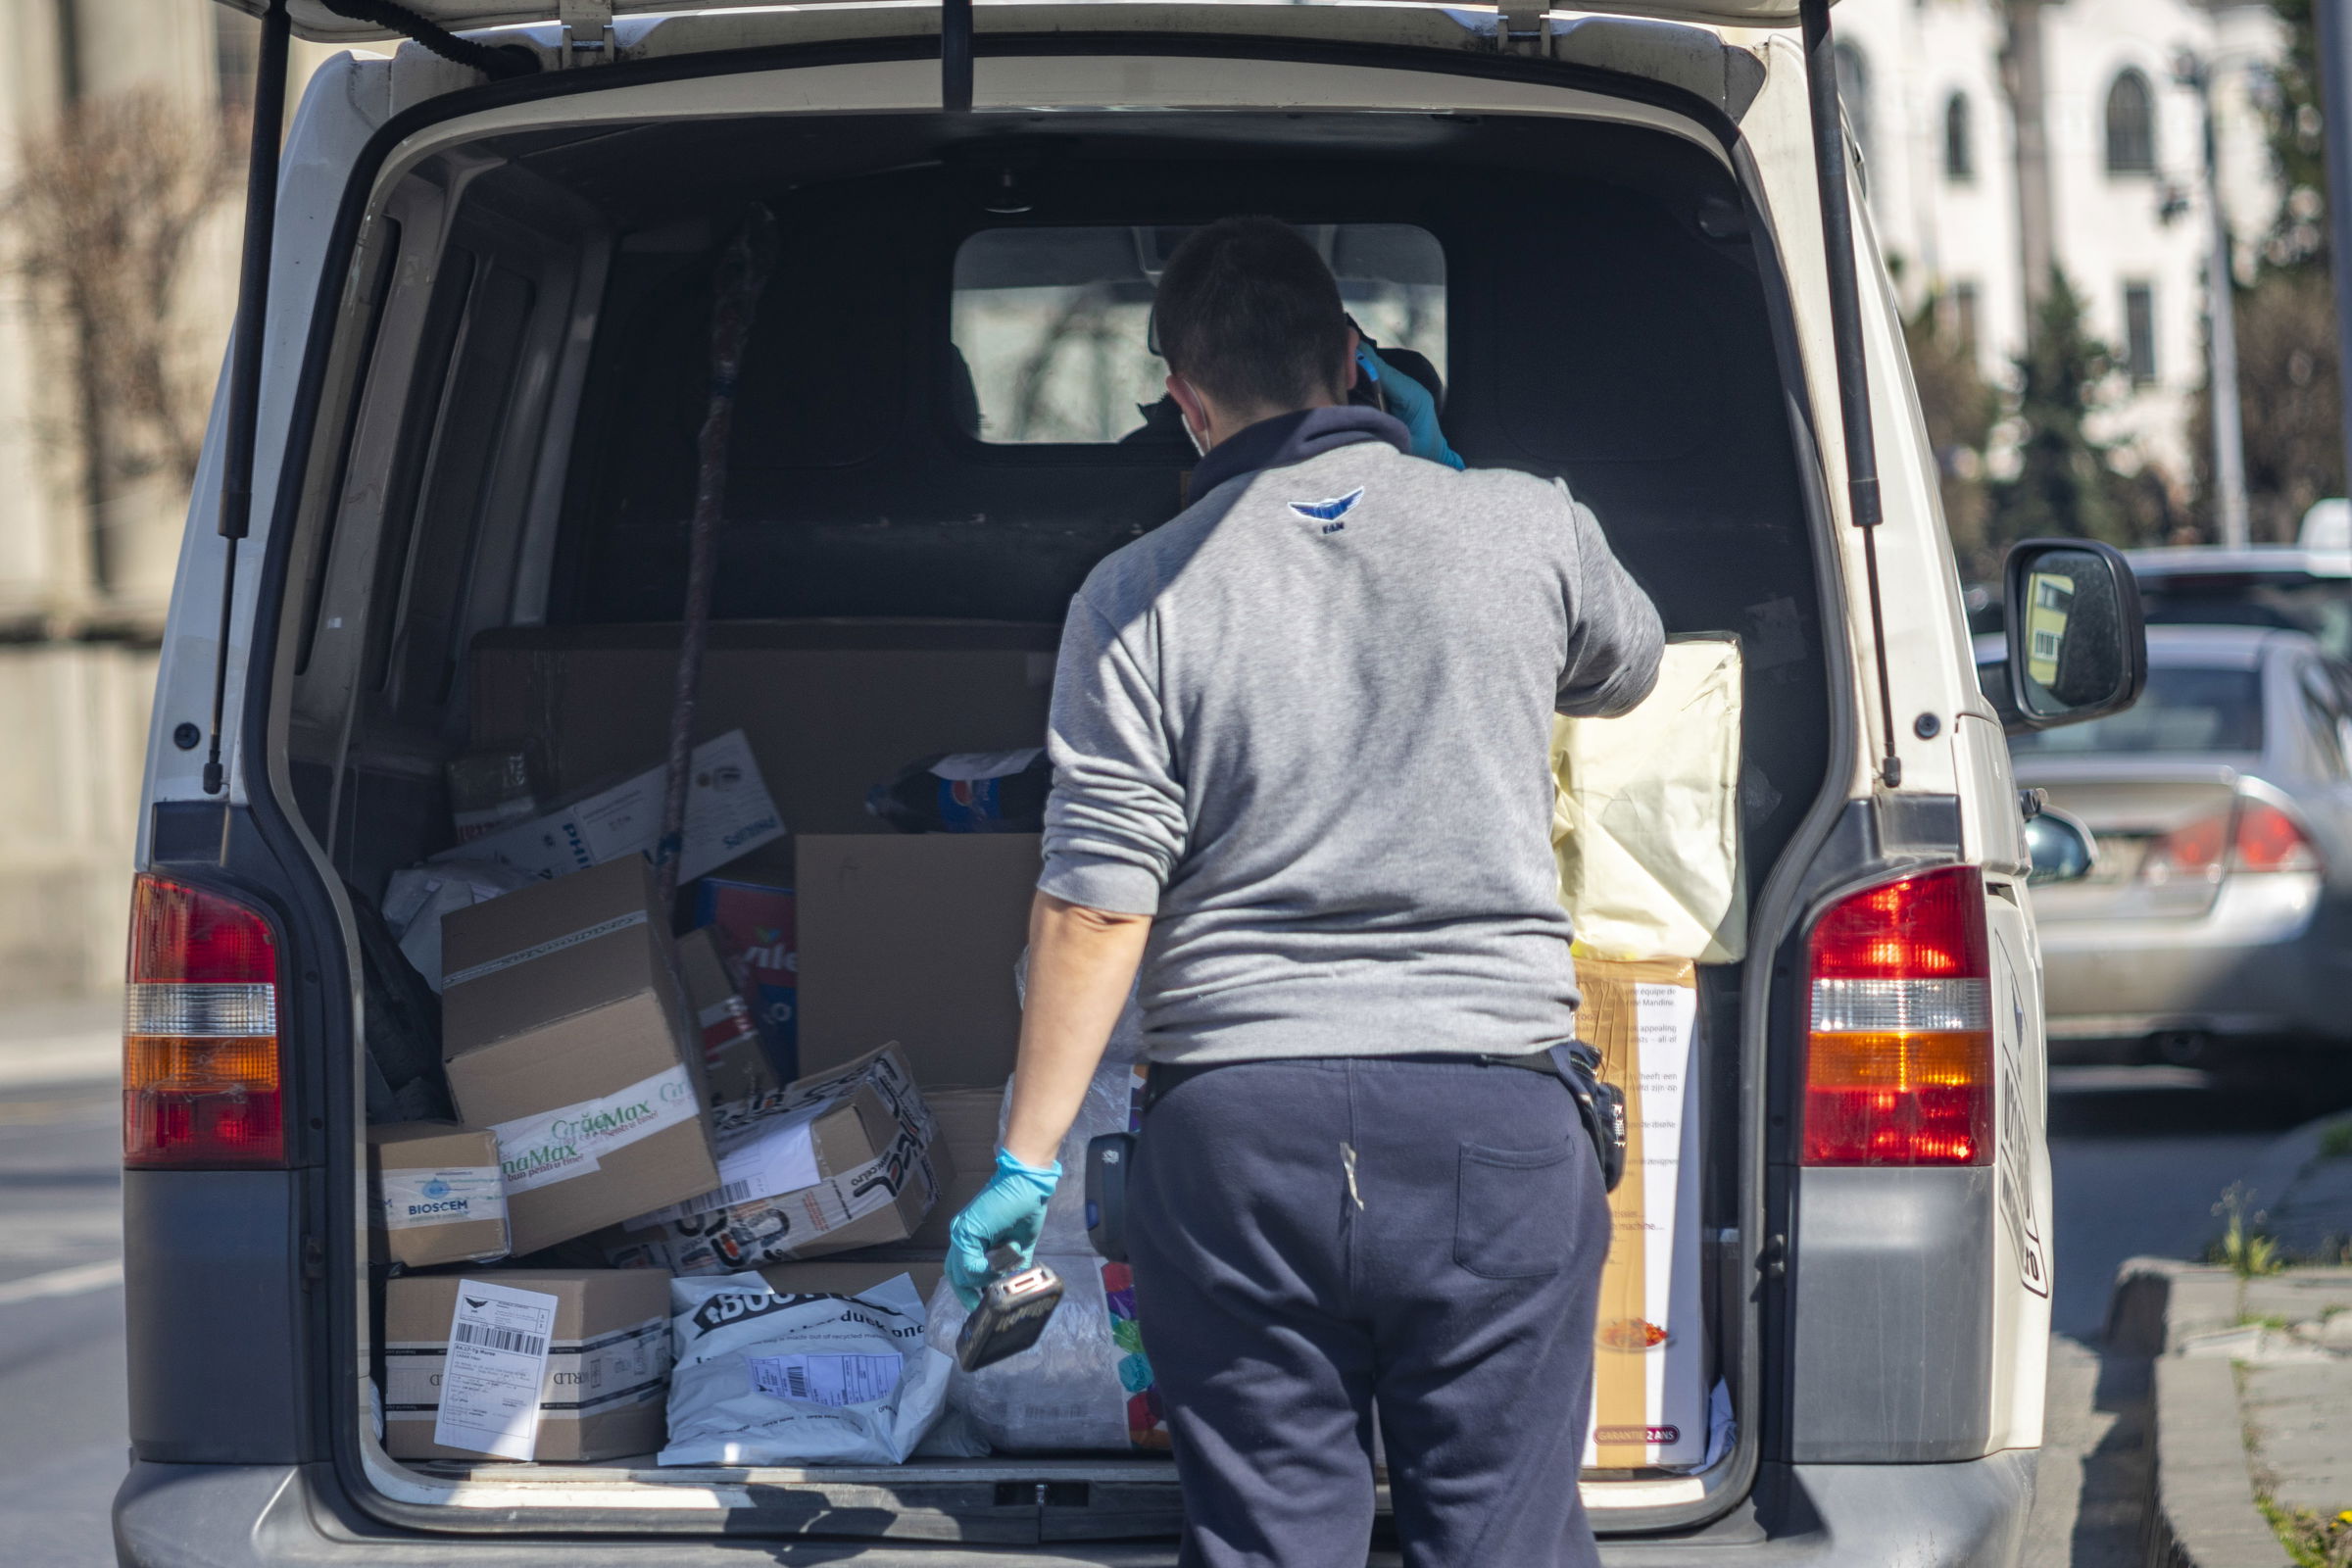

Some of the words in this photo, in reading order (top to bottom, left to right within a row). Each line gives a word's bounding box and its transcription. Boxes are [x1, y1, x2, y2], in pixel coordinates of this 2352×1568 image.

[408, 1199, 468, 1215] BIOSCEM
[1646, 1430, 1653, 1441] 2
[1654, 1430, 1676, 1441] ANS
